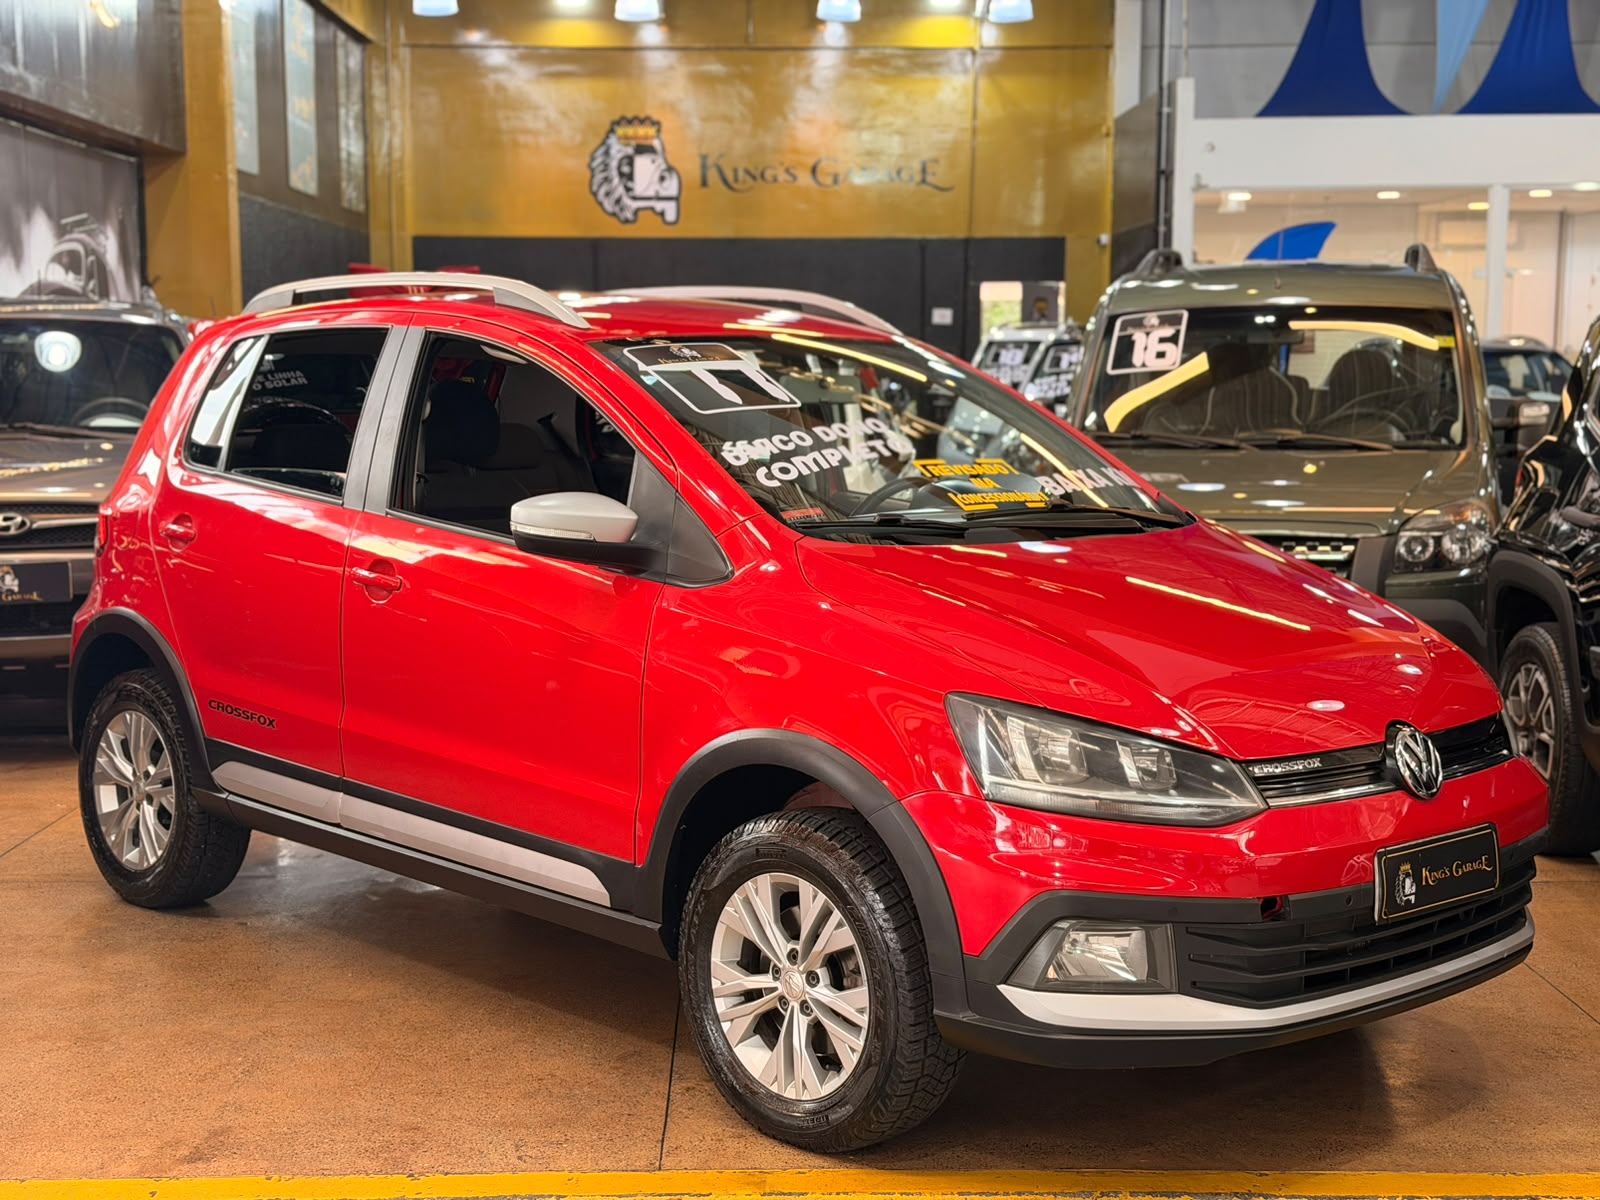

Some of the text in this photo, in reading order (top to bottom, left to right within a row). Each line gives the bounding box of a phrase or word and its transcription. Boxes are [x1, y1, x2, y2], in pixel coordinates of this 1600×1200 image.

[811, 155, 955, 193] GARAGE
[1131, 328, 1178, 368] 16
[755, 438, 911, 488] COMPLETO
[208, 699, 277, 729] CROSSFOX
[1253, 757, 1323, 775] CROSSFOX
[1421, 855, 1494, 886] KING'S GARAGE
